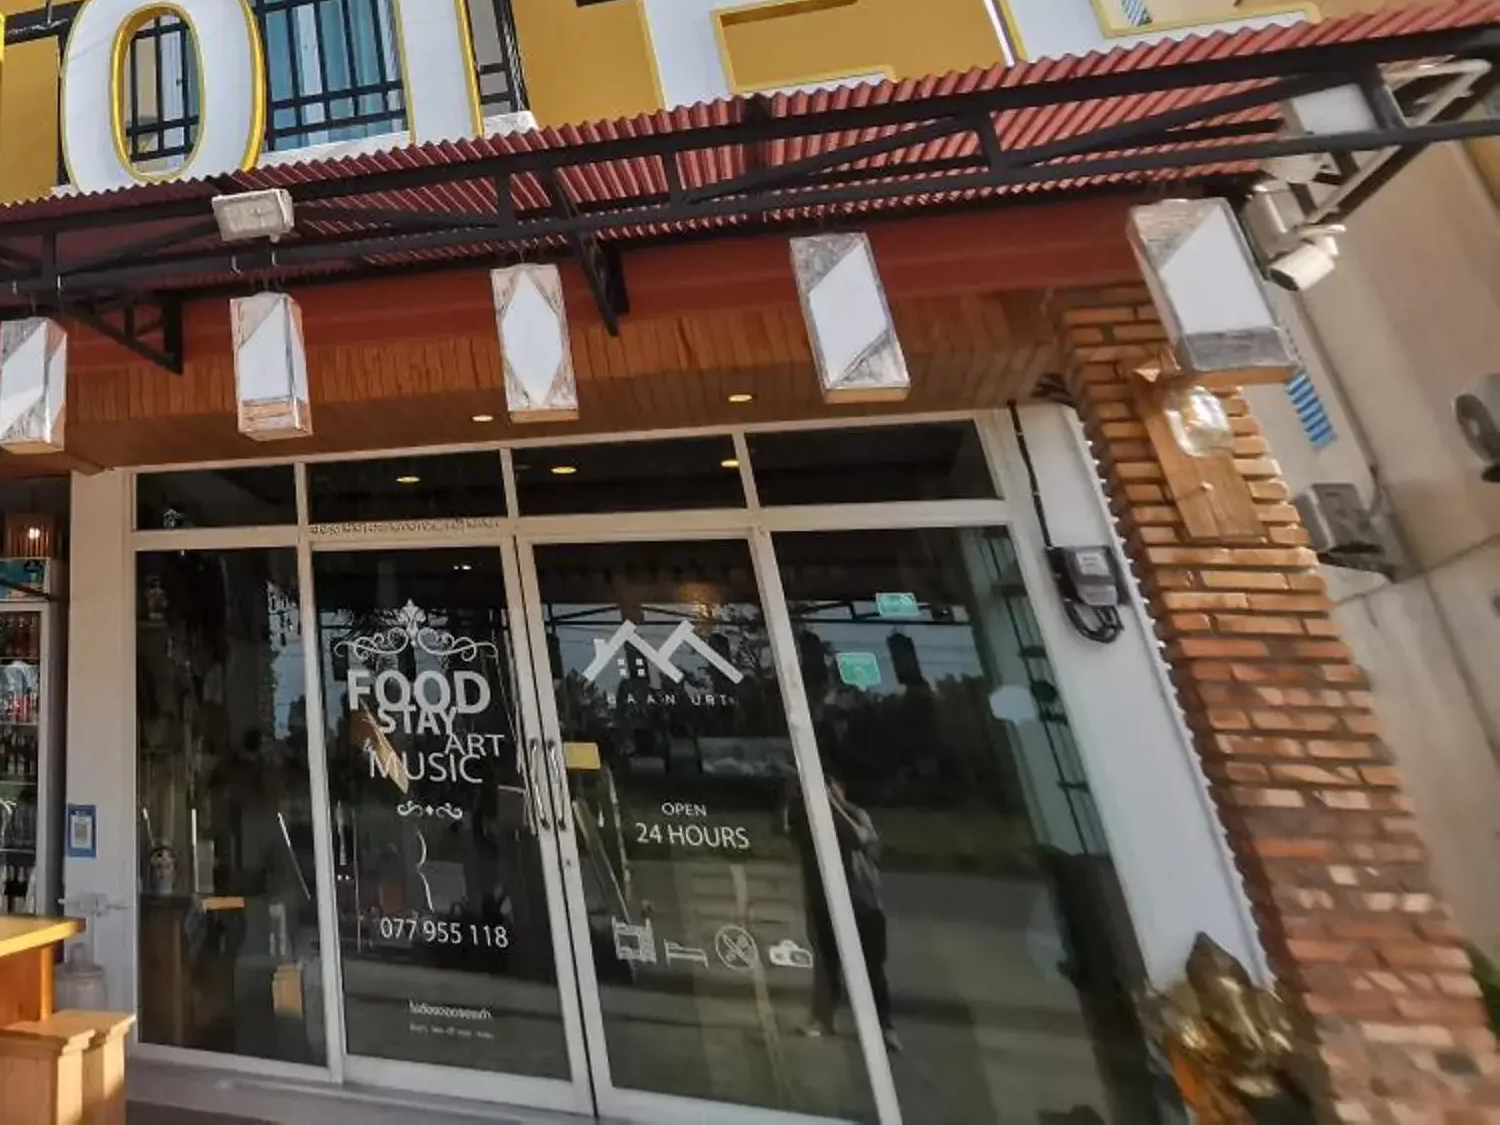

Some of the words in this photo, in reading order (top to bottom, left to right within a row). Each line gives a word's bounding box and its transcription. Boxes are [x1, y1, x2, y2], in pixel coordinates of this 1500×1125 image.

[346, 668, 492, 715] FOOD
[377, 706, 457, 736] STAY
[444, 732, 506, 758] ART
[368, 750, 485, 784] MUSIC
[660, 801, 709, 818] OPEN
[635, 822, 663, 845] 24
[668, 824, 752, 851] HOURS
[379, 915, 418, 942] 077
[423, 919, 463, 946] 955
[467, 922, 511, 949] 118
